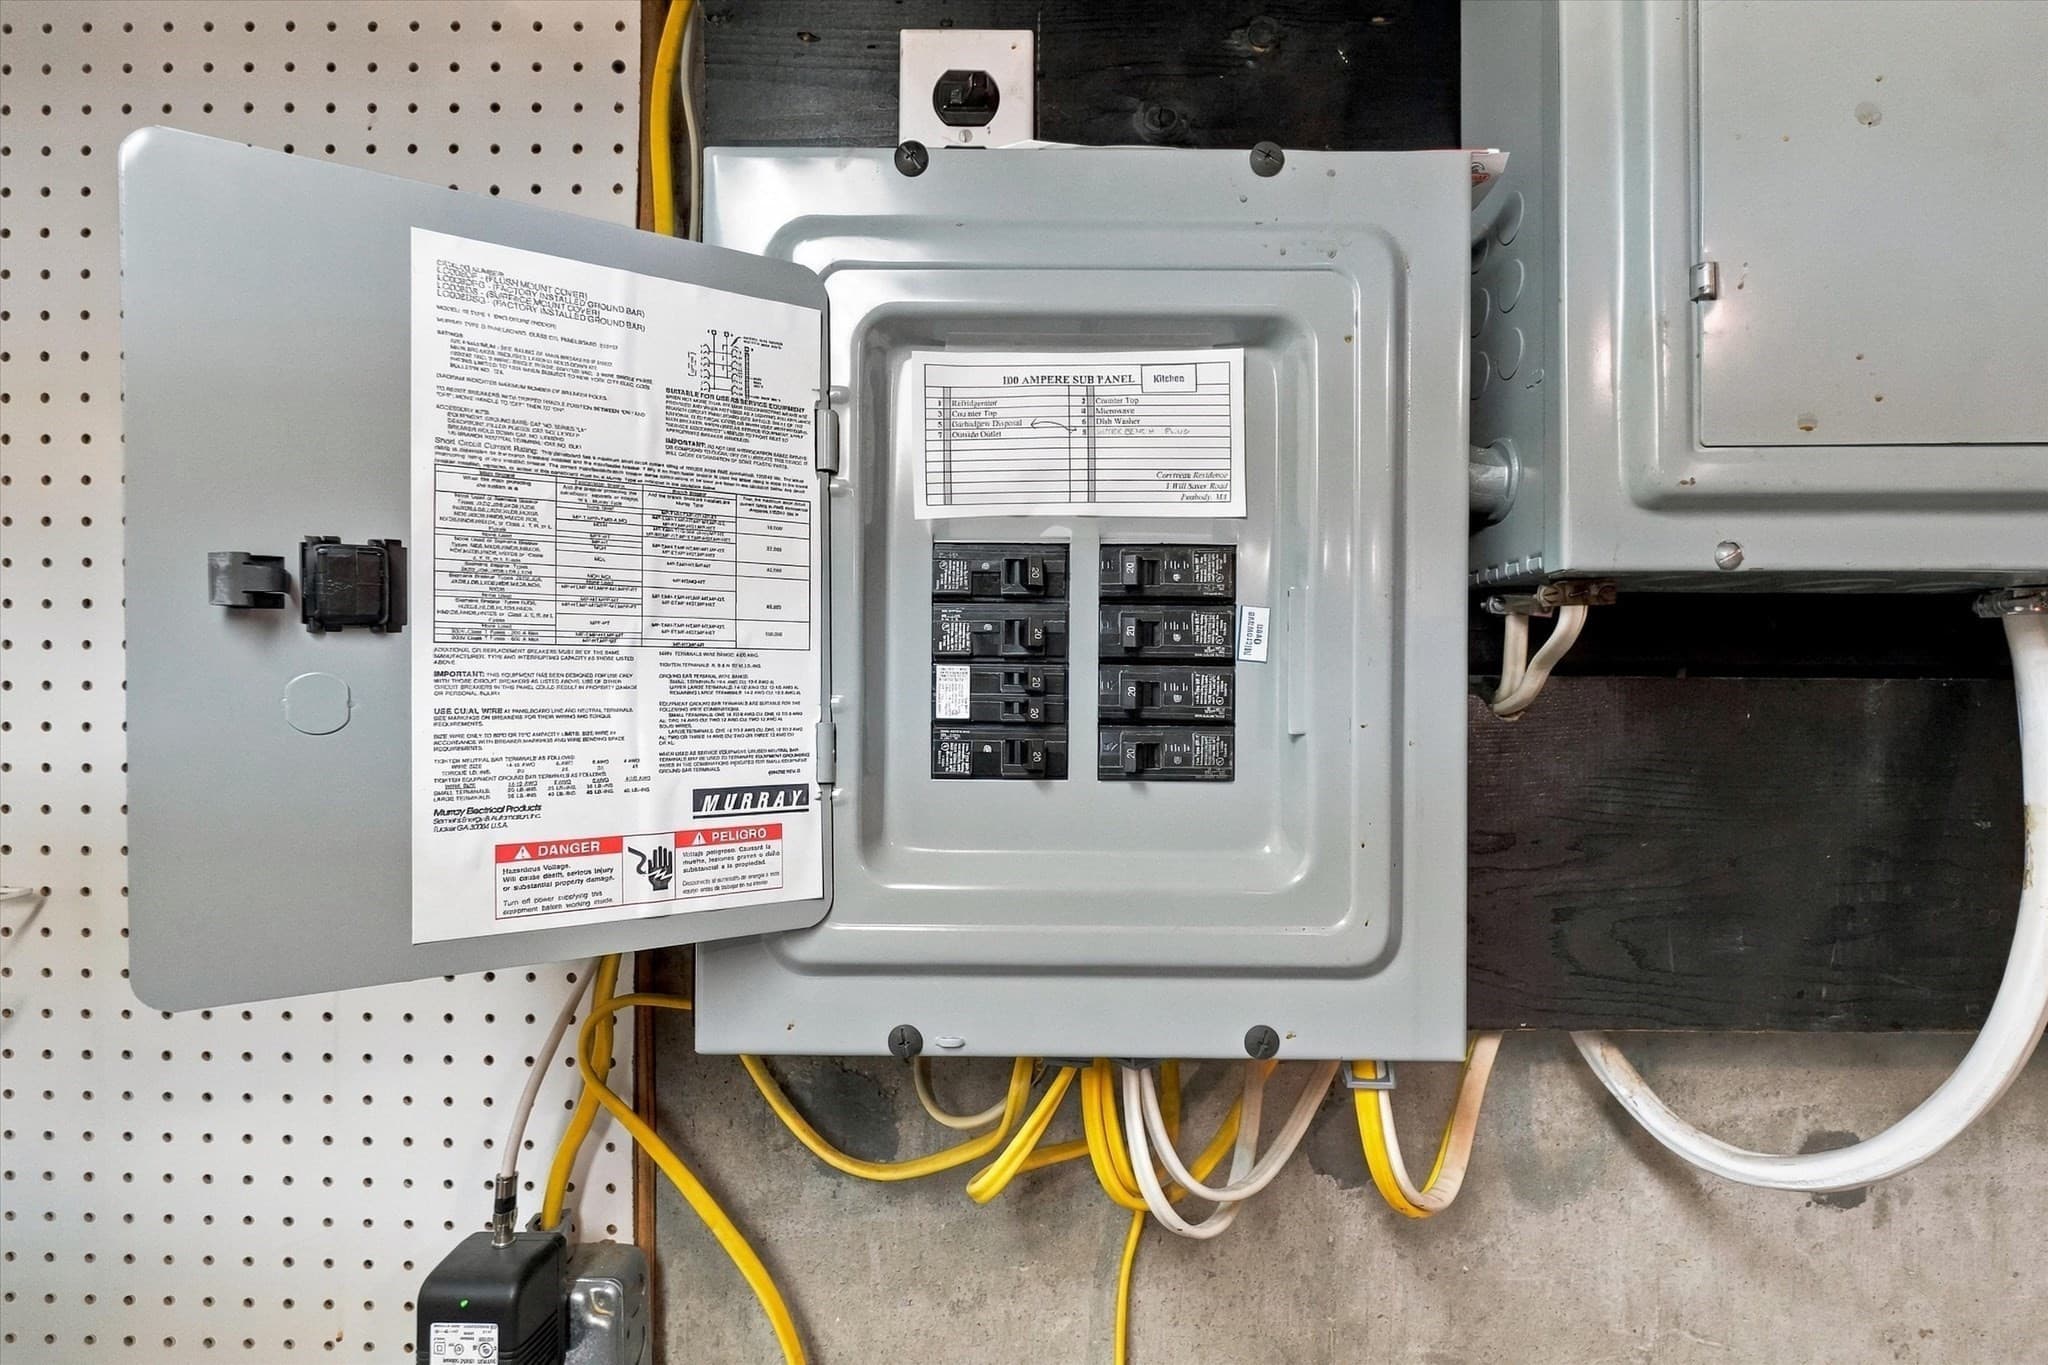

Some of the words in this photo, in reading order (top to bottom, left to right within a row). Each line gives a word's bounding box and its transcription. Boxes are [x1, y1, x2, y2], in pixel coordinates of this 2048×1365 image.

[587, 300, 624, 314] GROUND
[626, 306, 645, 319] BAR)
[587, 314, 625, 328] GROUND
[626, 321, 646, 333] BAR)
[1002, 376, 1019, 385] 100
[1022, 375, 1070, 385] AMPERE
[1073, 375, 1094, 384] SUB
[1098, 374, 1135, 384] PANEL
[1153, 374, 1185, 384] Kitchen
[665, 387, 699, 399] SUITABLE
[700, 391, 715, 400] FOR
[716, 393, 729, 402] USE
[1126, 397, 1139, 405] Top
[984, 411, 997, 419] Top
[484, 442, 511, 451] Current
[1209, 482, 1229, 490] Road
[1031, 566, 1040, 579] 20
[1126, 562, 1135, 575] 20
[1034, 628, 1042, 640] 20
[1127, 625, 1135, 638] 20
[1243, 610, 1256, 656] Microwave
[1253, 624, 1265, 646] Oven
[1032, 676, 1040, 689] 20
[1127, 685, 1136, 698] 20
[1030, 707, 1039, 720] 20
[1033, 751, 1042, 763] 20
[1126, 748, 1136, 760] 20
[701, 790, 803, 814] MURRAY
[433, 808, 466, 817] Murray
[466, 805, 506, 815] Electrical
[506, 803, 542, 813] Products
[712, 828, 767, 842] PELIGRO
[538, 841, 600, 857] DANGER
[708, 855, 734, 863] lesiones
[737, 853, 757, 861] graves
[503, 866, 541, 875] Hazardous
[543, 863, 571, 871] Voltage.
[543, 872, 565, 880] death,
[567, 869, 592, 877] serious
[513, 881, 552, 891] substantial
[555, 878, 584, 888] property
[586, 875, 615, 883] damage.
[503, 899, 519, 907] Turn
[534, 896, 554, 904] power
[558, 892, 588, 901] supplying
[592, 890, 603, 898] this
[503, 905, 538, 916] equipment
[541, 903, 563, 912] before
[566, 900, 591, 910] working
